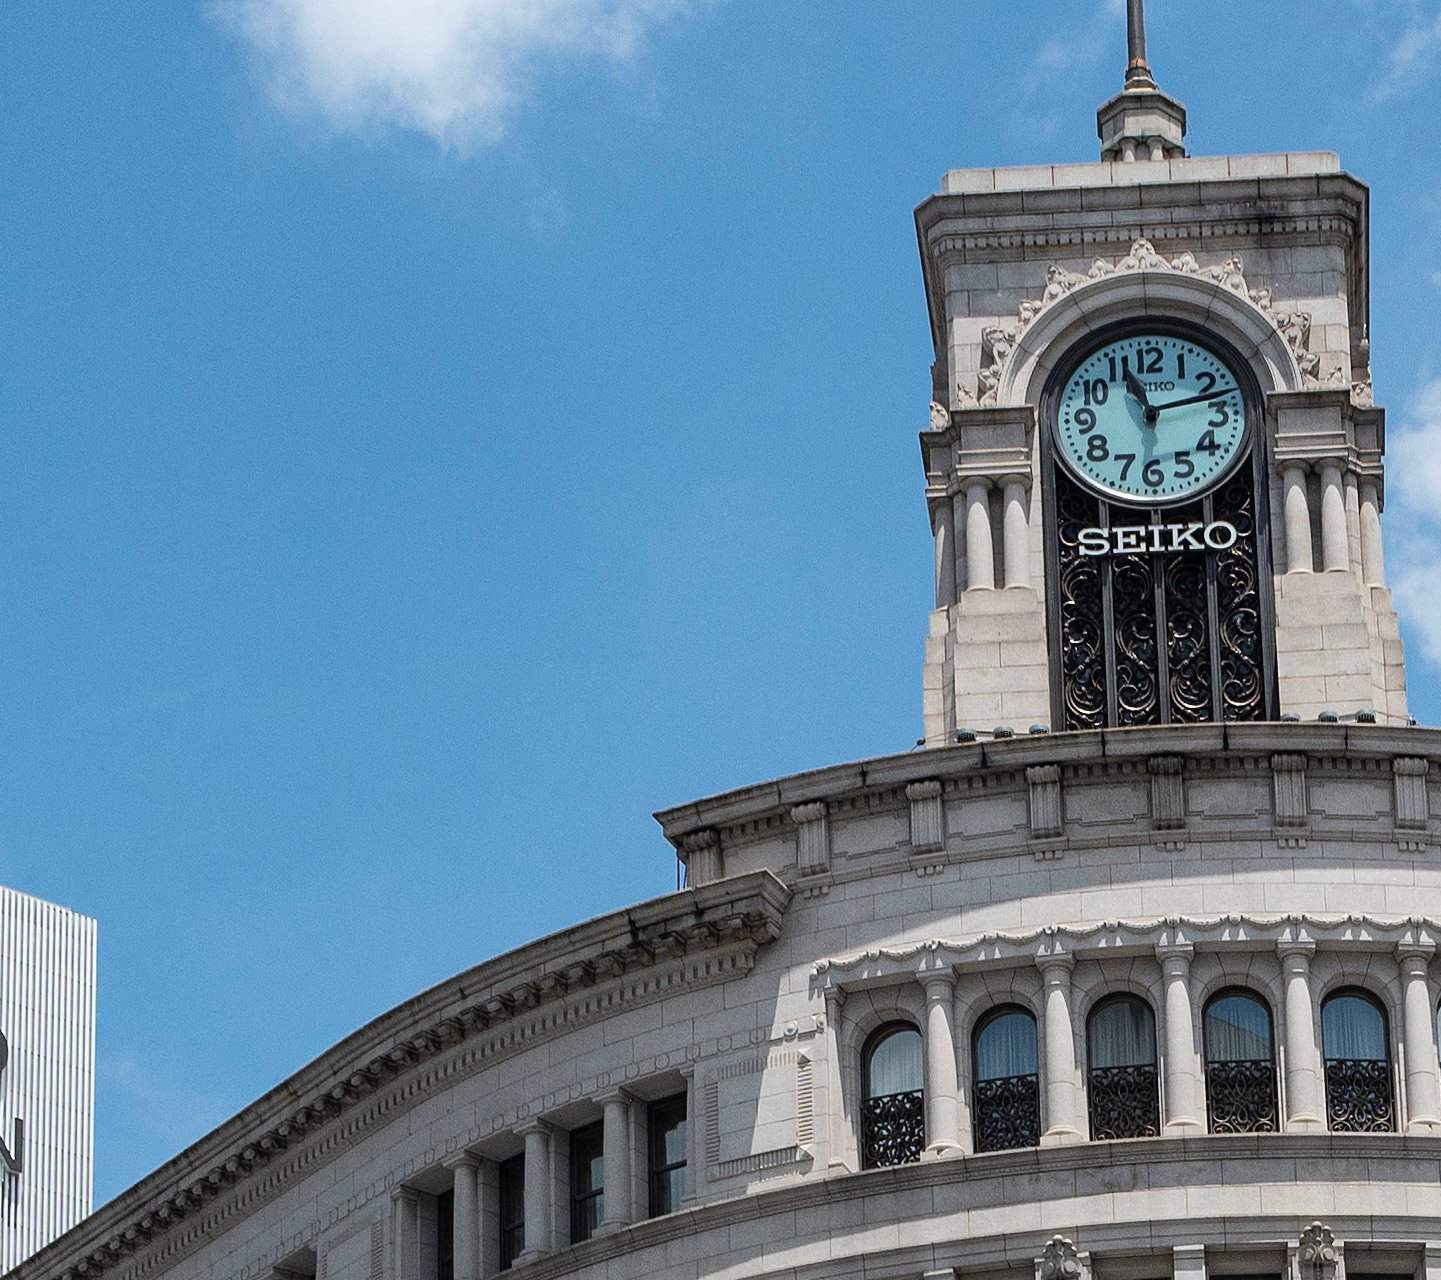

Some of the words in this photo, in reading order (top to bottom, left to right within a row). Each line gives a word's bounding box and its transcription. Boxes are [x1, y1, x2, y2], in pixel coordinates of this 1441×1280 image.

[1136, 347, 1164, 374] 12
[1176, 353, 1186, 379] 1
[1082, 378, 1109, 406] 10
[1143, 381, 1176, 393] EIKO
[1195, 372, 1217, 394] 2
[1074, 407, 1097, 435] 9
[1207, 401, 1230, 428] 3
[1086, 434, 1110, 462] 8
[1195, 430, 1222, 457] 4
[1113, 454, 1137, 481] 7
[1141, 459, 1165, 488] 6
[1173, 451, 1195, 479] 5
[1078, 520, 1238, 556] SEIKO
